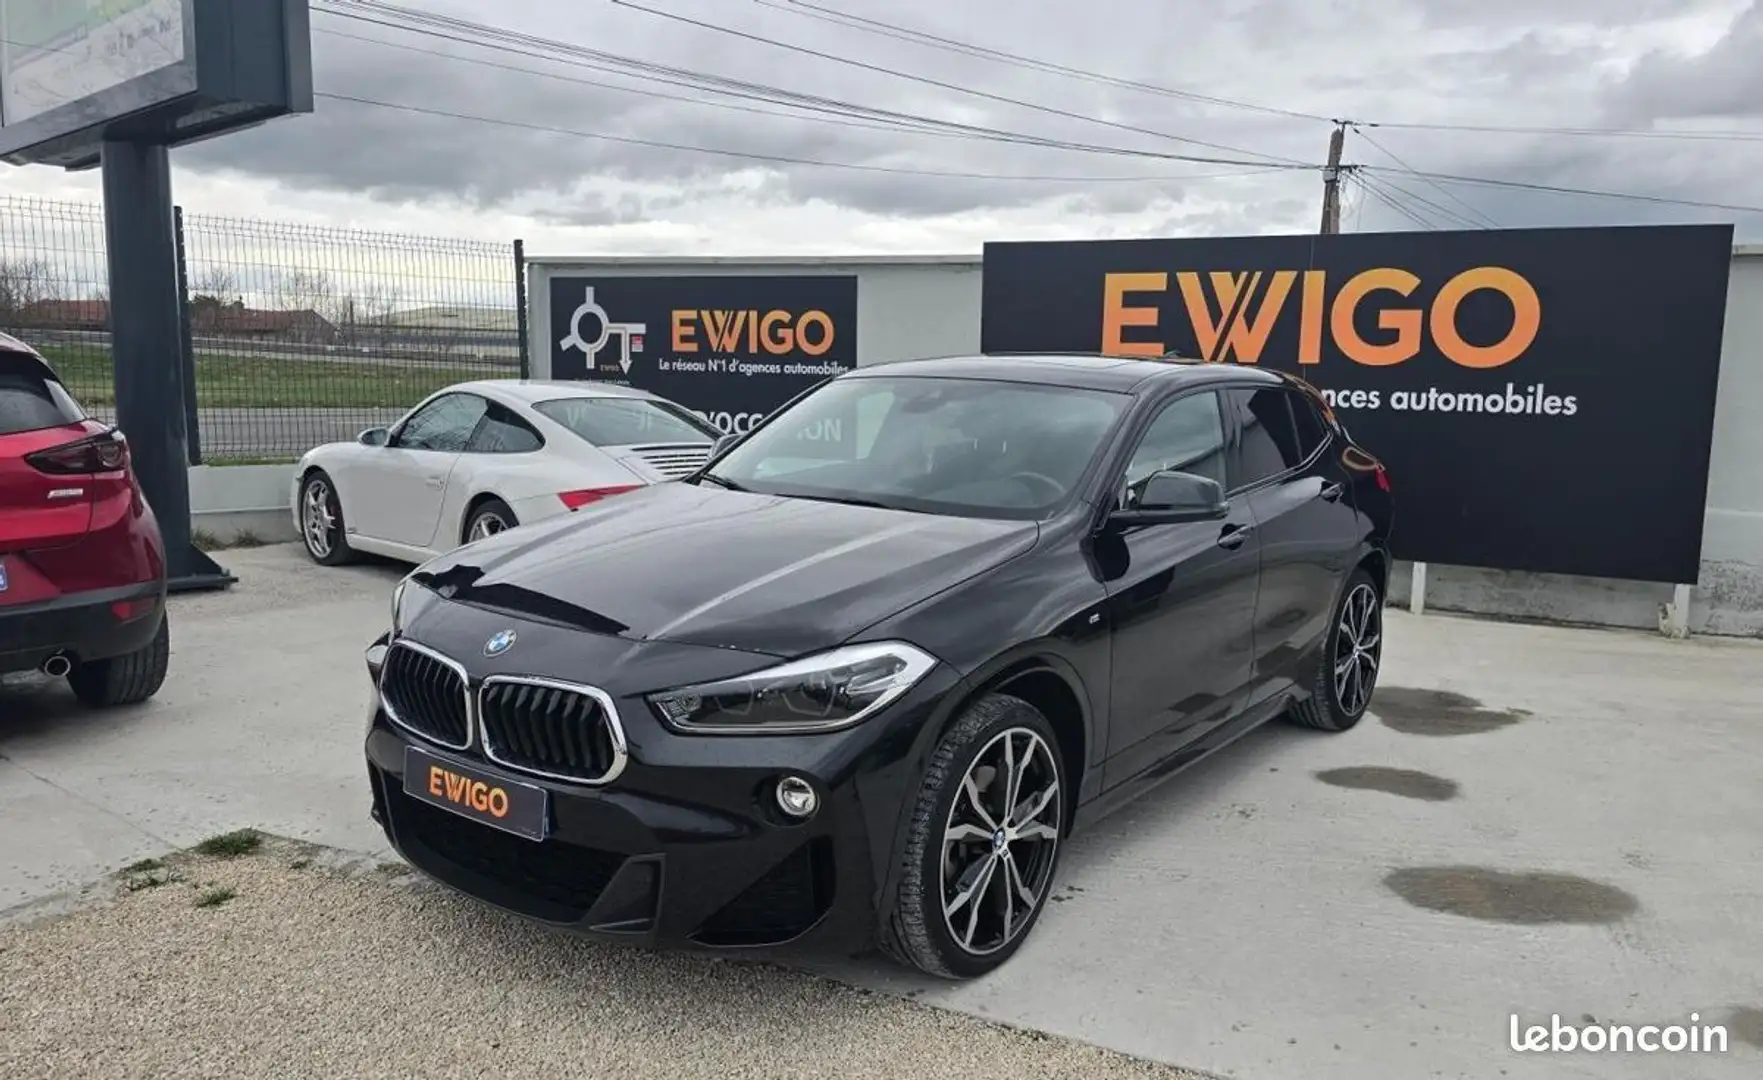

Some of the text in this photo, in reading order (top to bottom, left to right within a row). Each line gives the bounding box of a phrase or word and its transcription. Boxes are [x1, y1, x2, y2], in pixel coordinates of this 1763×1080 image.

[671, 309, 835, 355] EWIGO
[1101, 266, 1541, 368] EWIGO
[658, 357, 670, 371] Le
[672, 358, 706, 372] réseau
[728, 359, 781, 376] d'agences
[784, 361, 849, 376] automobiles
[1321, 382, 1578, 416] nces automobiles
[429, 765, 509, 818] EWIGO
